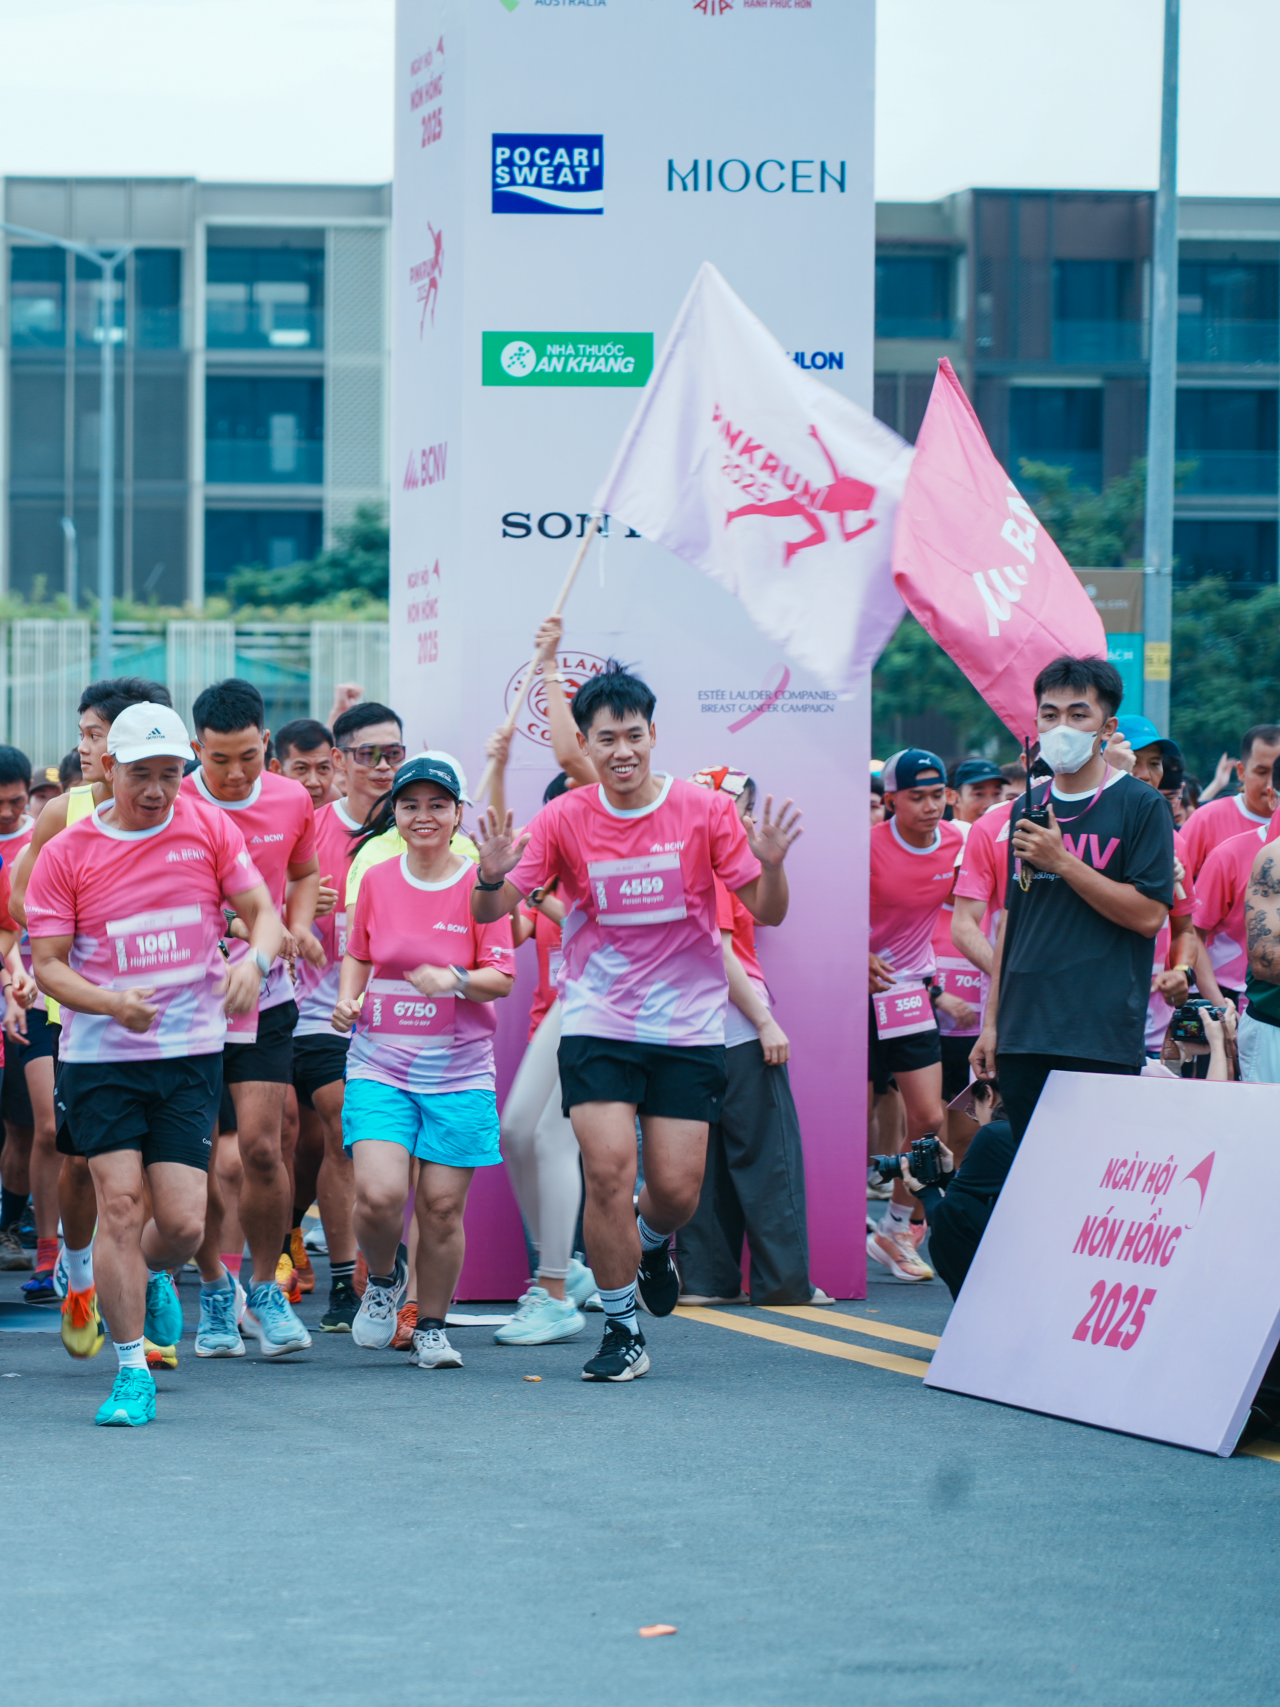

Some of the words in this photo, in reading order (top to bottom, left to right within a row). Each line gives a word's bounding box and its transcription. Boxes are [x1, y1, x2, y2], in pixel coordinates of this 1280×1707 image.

[495, 147, 601, 166] POCARI
[495, 167, 591, 186] SWEAT
[667, 159, 847, 193] MIOCEN
[546, 342, 575, 356] NHÀ
[577, 341, 625, 356] THUỐC
[534, 356, 565, 373] AN
[566, 356, 636, 373] KHANG
[421, 441, 448, 488] BCNV
[698, 689, 726, 700] ESTÉE
[730, 690, 773, 700] LAUDER
[774, 690, 837, 700] COMPANIES
[701, 704, 737, 713] BREAST
[739, 704, 779, 713] CANCER
[781, 704, 835, 713] CAMPAIGN
[264, 833, 284, 843] BCNV
[619, 876, 664, 896] 4559
[447, 923, 468, 934] BCNV
[136, 931, 177, 956] 1061
[372, 998, 383, 1027] 15KM
[393, 1001, 437, 1018] 6750
[895, 995, 923, 1012] 3560
[1099, 1151, 1149, 1192] NGÀY
[1141, 1155, 1179, 1206] HỘI
[1072, 1206, 1123, 1259] NÓN
[1116, 1208, 1182, 1268] HỒNG
[1072, 1279, 1158, 1351] 2025
